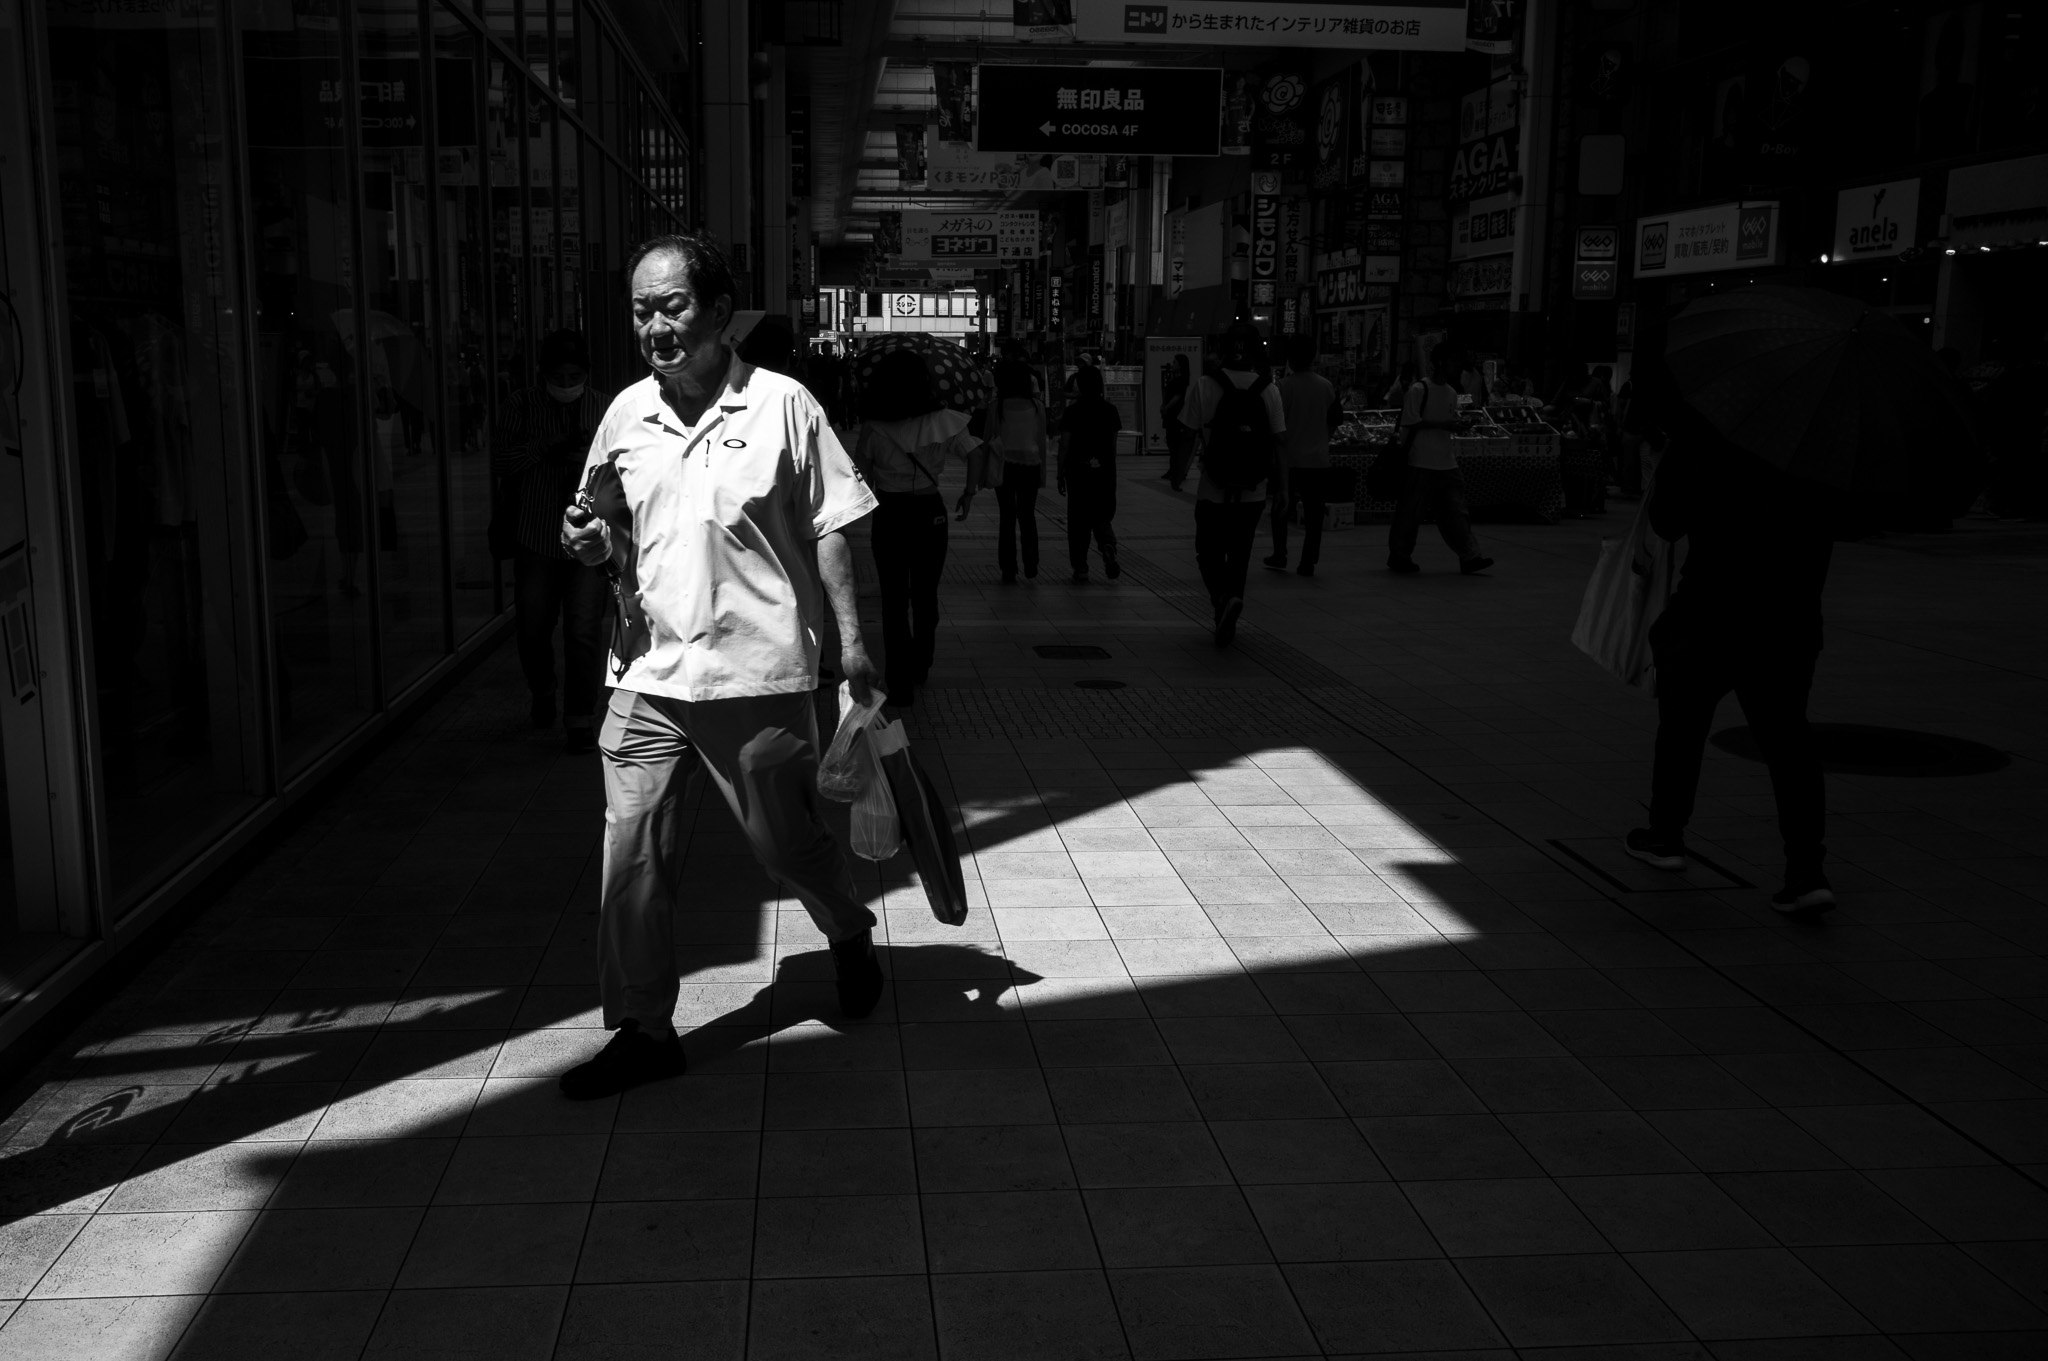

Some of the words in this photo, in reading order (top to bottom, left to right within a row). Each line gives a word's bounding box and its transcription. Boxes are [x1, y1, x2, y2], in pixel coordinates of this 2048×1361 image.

[1128, 11, 1164, 28] ニトリ
[1172, 13, 1420, 36] から生まれたインテリア雑貨のお店
[1056, 87, 1145, 112] 無印良品
[1062, 124, 1119, 136] COCOSA
[1122, 124, 1139, 137] 4F
[1270, 153, 1292, 165] 2F
[1451, 136, 1508, 182] AGA
[1449, 171, 1508, 200] スキンクリニ
[1372, 193, 1400, 204] AGA
[938, 217, 993, 233] メガネの
[1679, 222, 1726, 239] スマホ/タブレット
[1849, 217, 1898, 245] anela
[936, 237, 993, 253] ヨネザワ
[1583, 235, 1612, 247] GEO
[1674, 238, 1729, 259] 買取/販売/契約
[1581, 270, 1610, 282] GEO
